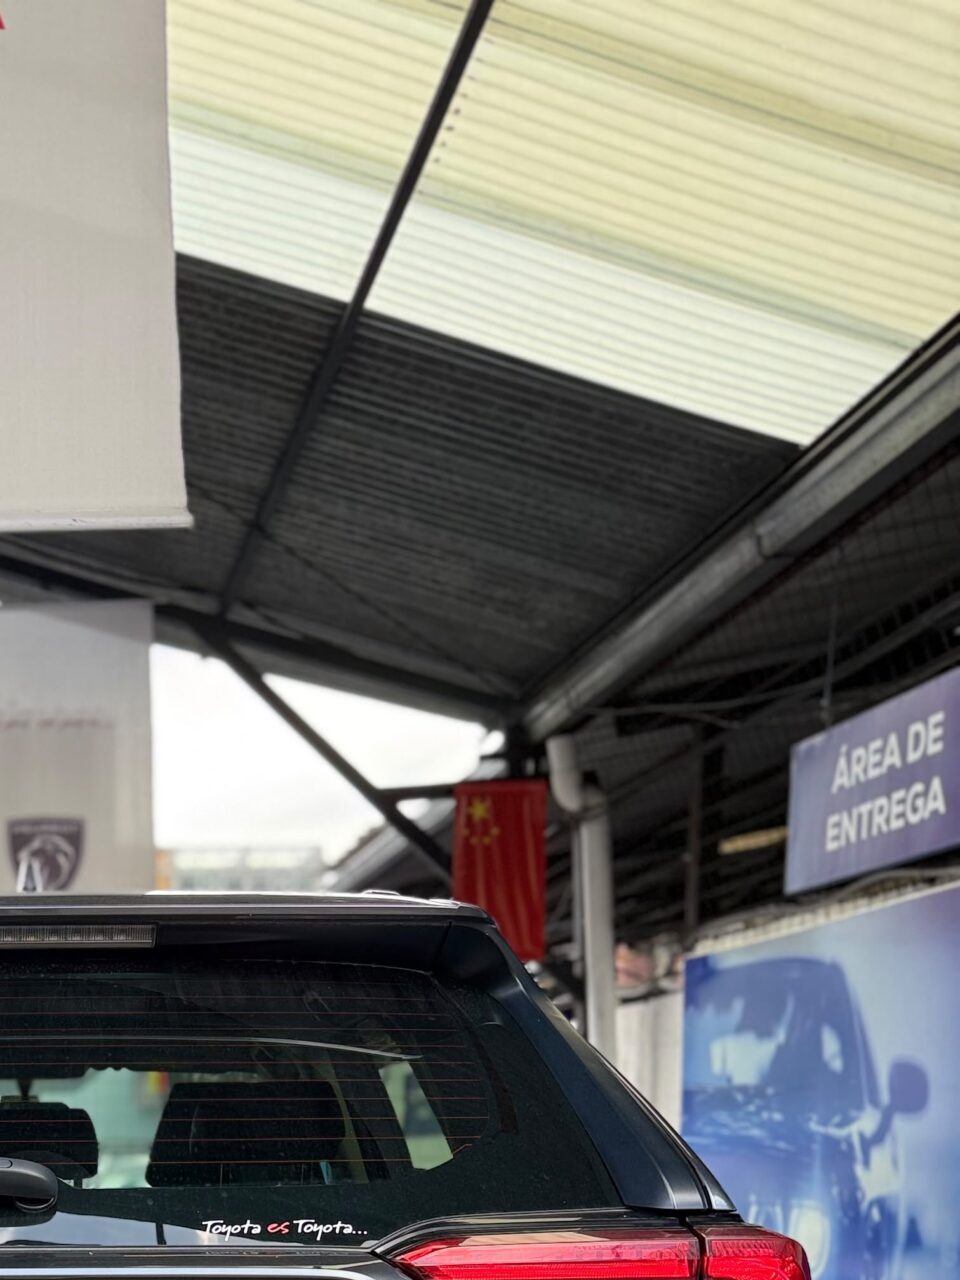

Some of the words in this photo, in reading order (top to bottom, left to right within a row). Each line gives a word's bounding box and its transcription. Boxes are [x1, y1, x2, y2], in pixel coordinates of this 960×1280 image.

[831, 731, 903, 794] ÁREA
[906, 710, 945, 764] DE
[824, 776, 947, 852] ENTREGA
[201, 1219, 262, 1242] Toyota
[267, 1221, 290, 1234] es
